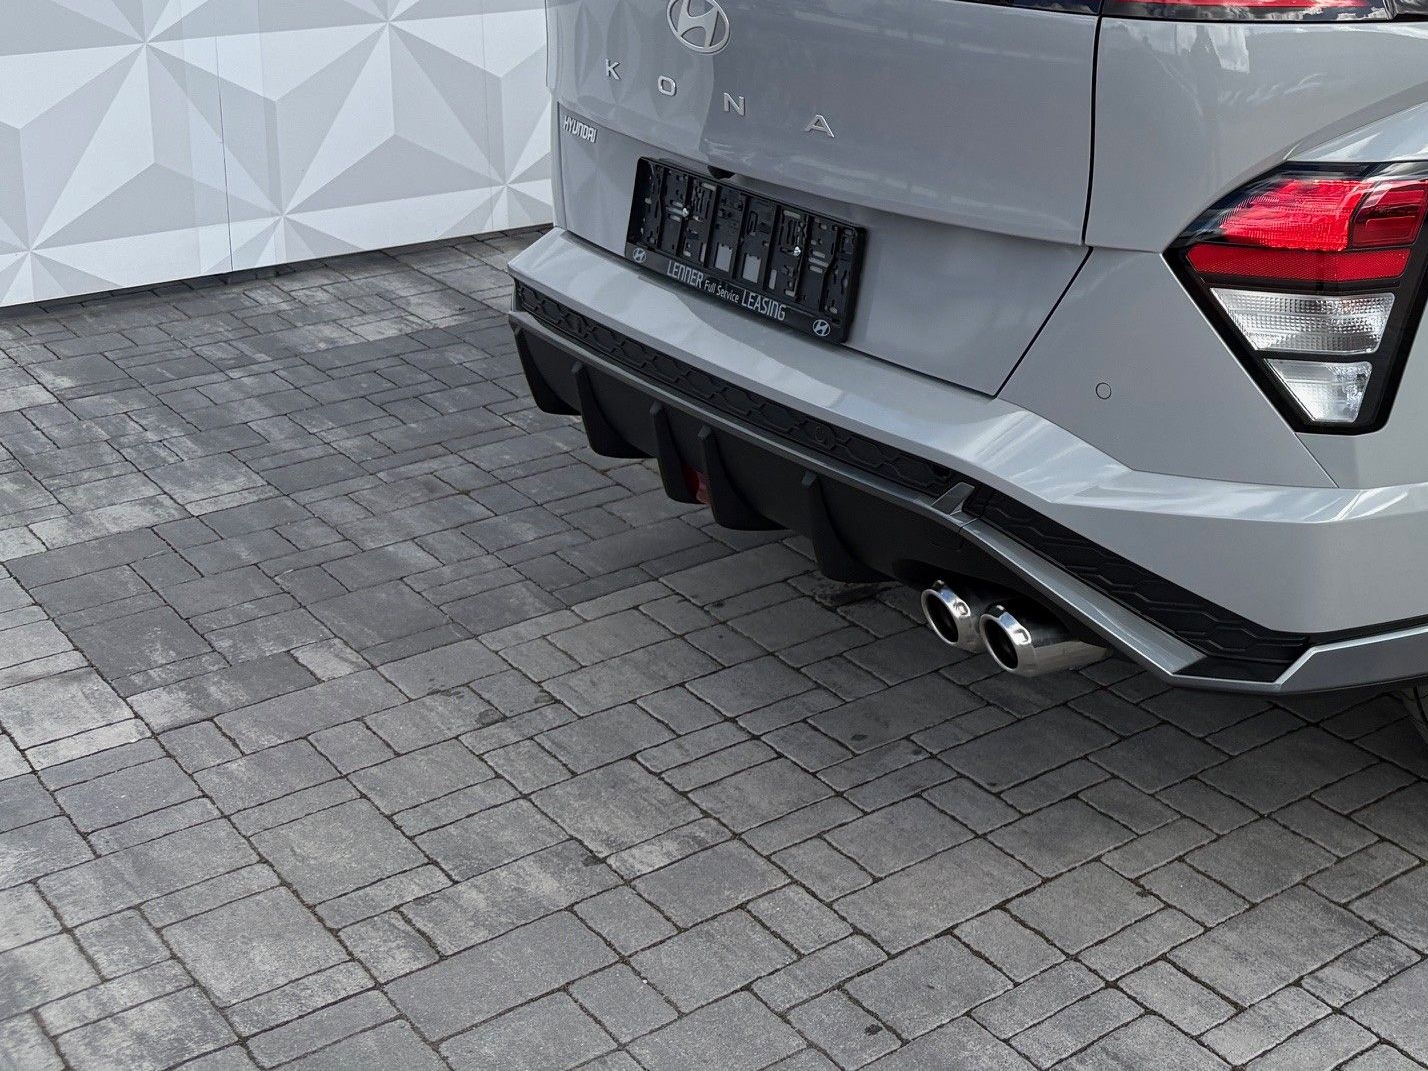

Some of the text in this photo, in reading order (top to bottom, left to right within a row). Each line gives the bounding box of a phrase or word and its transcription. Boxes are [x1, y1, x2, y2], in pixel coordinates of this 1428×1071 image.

[563, 115, 598, 143] HYUNDAI
[605, 58, 835, 139] KONA
[666, 260, 788, 322] LENNER Full Service LEASING
